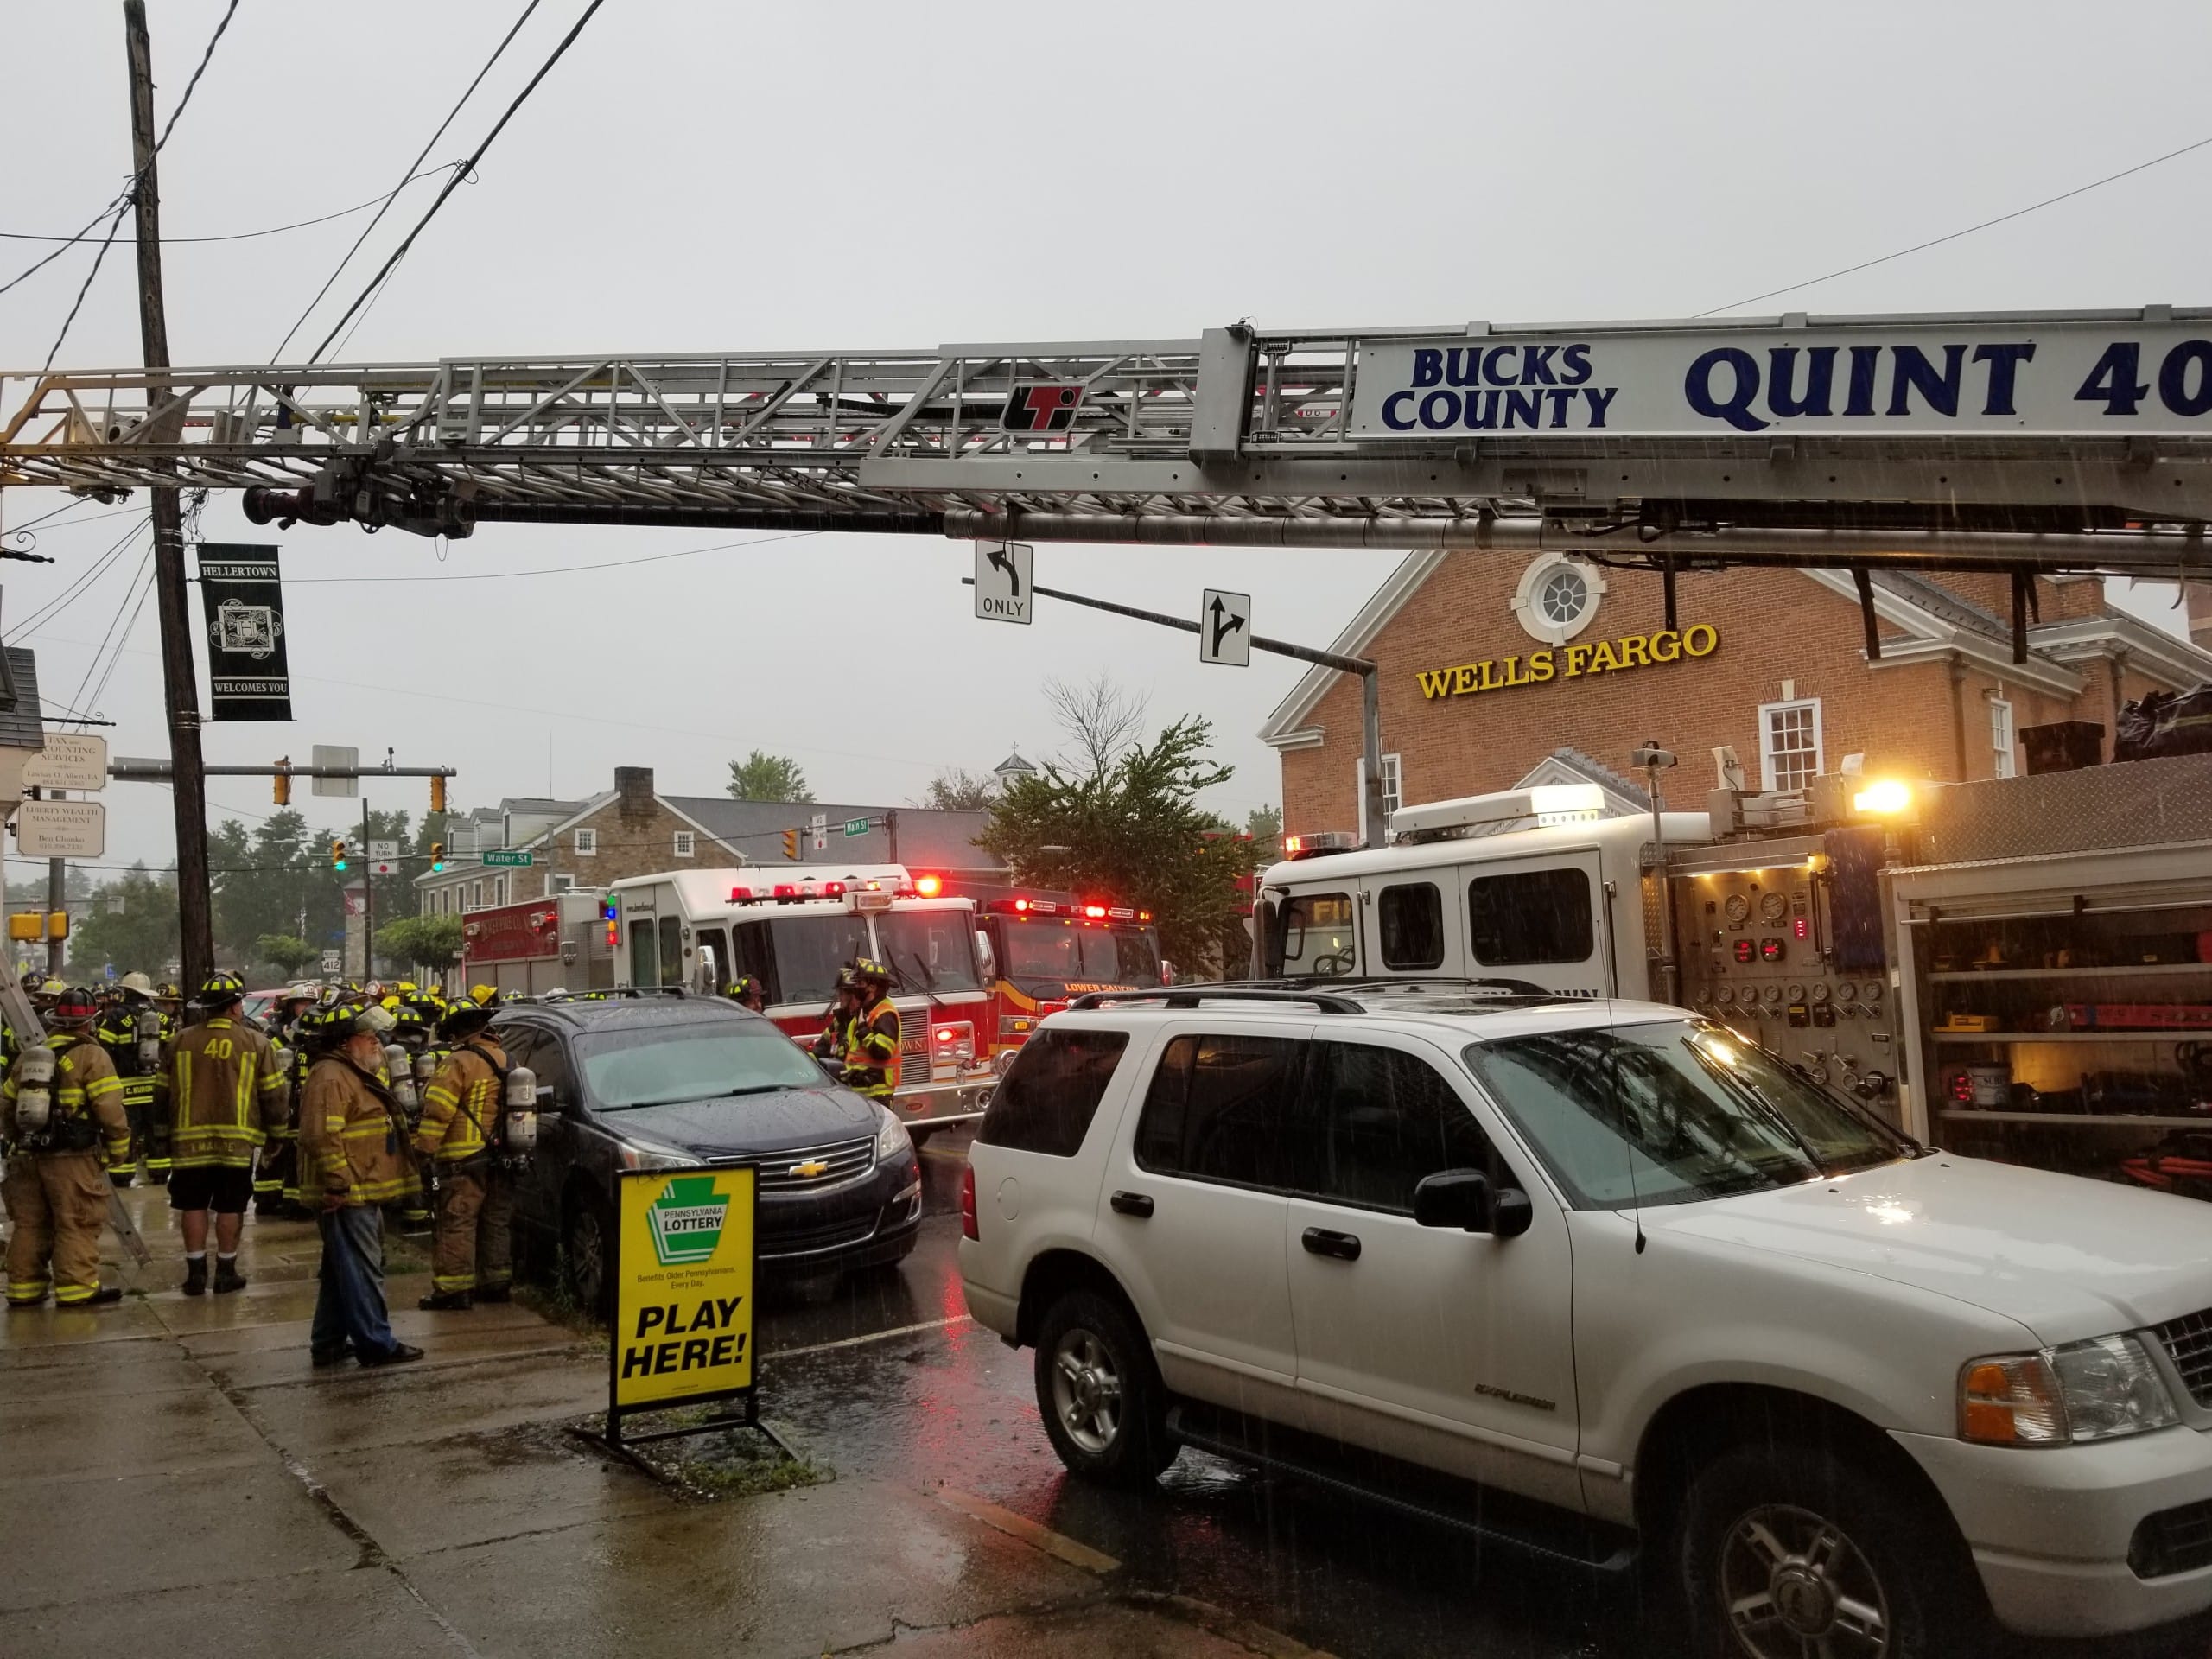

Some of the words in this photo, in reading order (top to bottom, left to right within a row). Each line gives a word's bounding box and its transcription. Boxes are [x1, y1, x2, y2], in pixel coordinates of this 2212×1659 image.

[1410, 344, 1592, 387] BUCKS
[1684, 343, 2037, 431] QUINT
[2073, 340, 2212, 416] 40
[1381, 387, 1618, 430] COUNTY
[202, 566, 276, 577] HELLERTOWN
[983, 597, 1024, 616] ONLY
[1415, 650, 1557, 700] WELLS
[1564, 624, 1721, 677] FARGO
[213, 683, 267, 693] WELCOMES
[268, 683, 287, 692] YOU
[847, 822, 860, 832] Main
[487, 854, 516, 863] Water
[518, 854, 528, 863] St
[1065, 983, 1100, 992] LOWER
[204, 1038, 232, 1059] 40
[664, 1208, 722, 1218] PENNSYLVANIA
[664, 1216, 722, 1232] LOTTERY
[637, 1273, 664, 1283] Benefits
[666, 1271, 684, 1280] Older
[671, 1281, 690, 1290] Every
[691, 1279, 705, 1287] Day.
[636, 1296, 744, 1338] PLAY
[621, 1332, 747, 1379] HERE!
